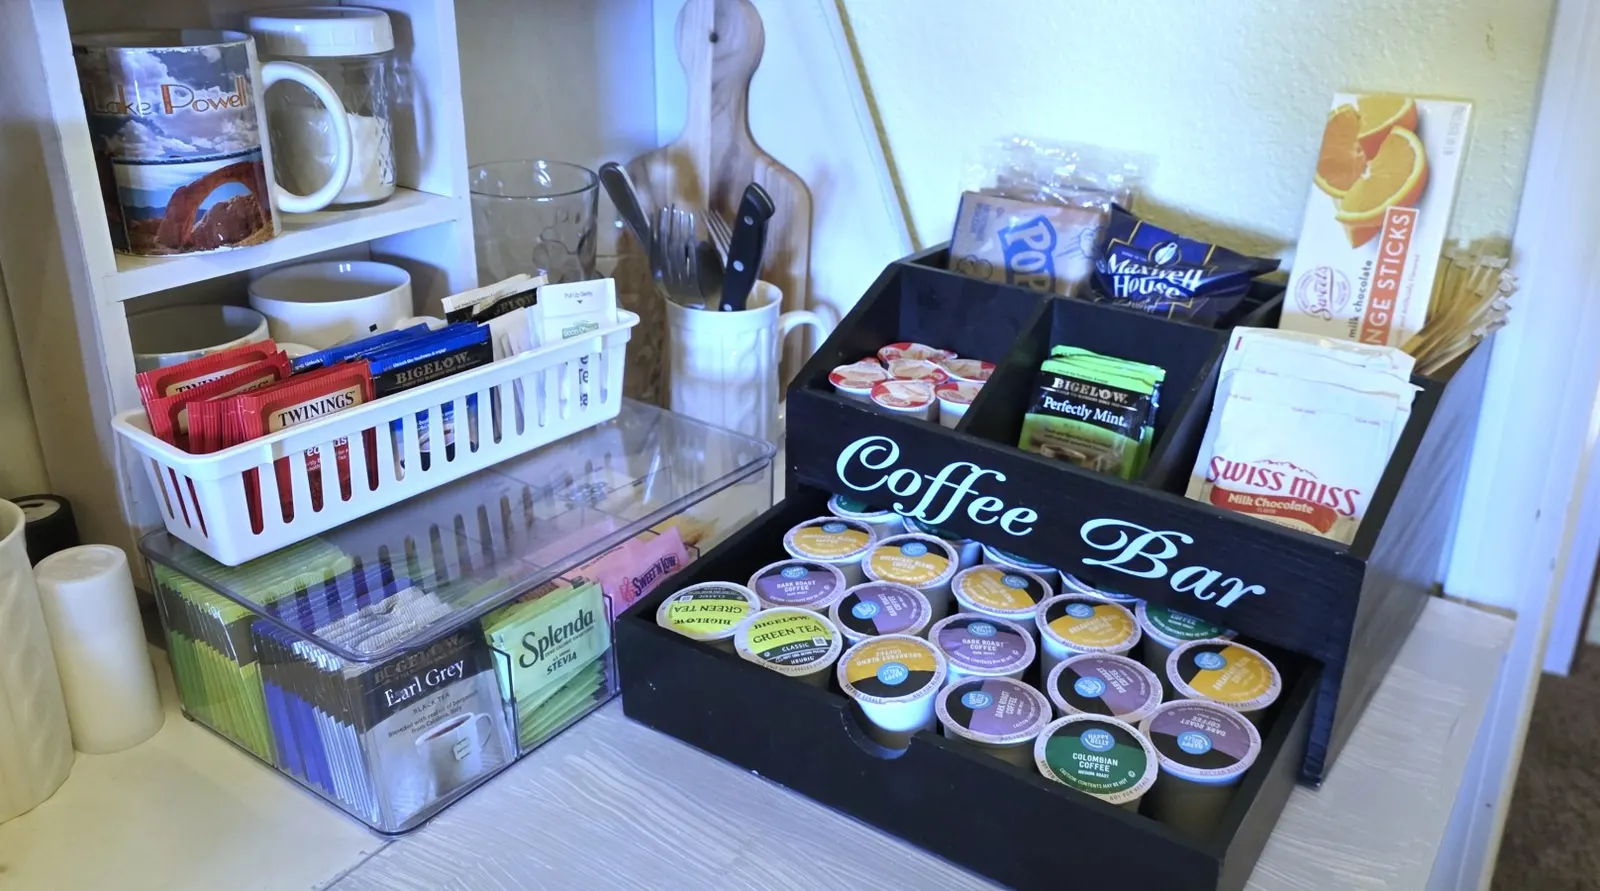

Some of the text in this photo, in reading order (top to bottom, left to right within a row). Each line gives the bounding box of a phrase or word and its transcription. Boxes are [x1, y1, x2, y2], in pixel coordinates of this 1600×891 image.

[87, 76, 247, 115] Lake Powell
[1107, 252, 1203, 292] Maxwell
[1366, 213, 1411, 344] NGE STICKS
[1113, 275, 1180, 299] House
[1347, 259, 1373, 338] milk chocolate
[278, 390, 356, 428] TWININGS
[1043, 396, 1093, 421] Perfectly
[1205, 455, 1286, 491] SWISS
[1228, 492, 1314, 515] Milk Chocolate
[836, 435, 1267, 609] Coffee Bar
[661, 554, 677, 575] LOW
[795, 579, 816, 587] ROAST
[674, 605, 743, 614] GREEN TEA
[1170, 614, 1196, 625] COFFEE
[519, 608, 595, 669] Splenda
[753, 625, 822, 643] GREEN TEA
[981, 639, 1004, 647] ROAST
[782, 642, 810, 652] CLASSIC
[547, 651, 577, 675] STEVIA
[384, 660, 464, 708] Earl Grey
[1180, 718, 1226, 737] DARK ROAST
[1191, 716, 1221, 728] COFFEE
[1090, 738, 1109, 746] BELLY
[1181, 741, 1203, 749] HAPPY
[1072, 752, 1119, 766] COLOMBIAN
[1079, 760, 1111, 772] COFFEE
[1077, 779, 1102, 788] CONTENTS
[1119, 777, 1128, 785] HOT
[1122, 790, 1133, 798] FOR
